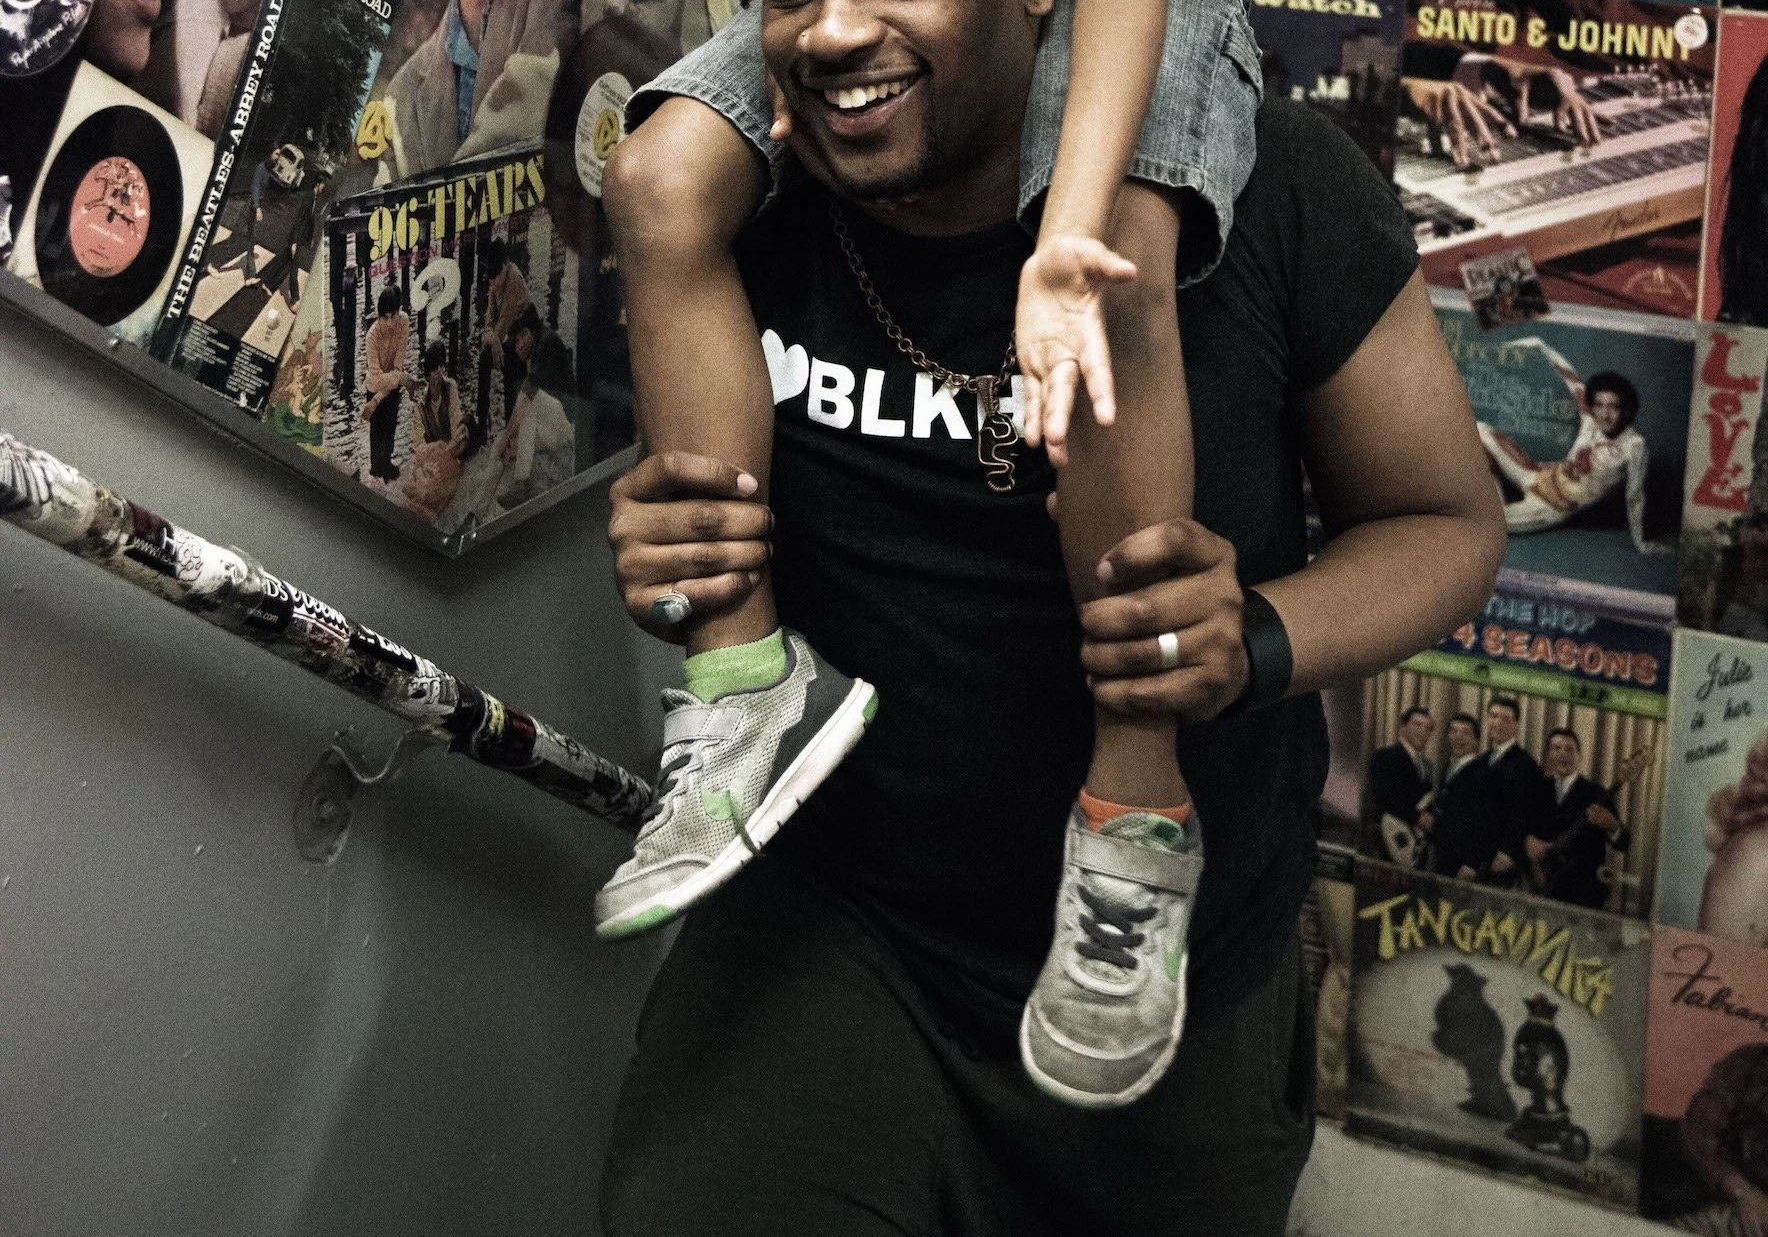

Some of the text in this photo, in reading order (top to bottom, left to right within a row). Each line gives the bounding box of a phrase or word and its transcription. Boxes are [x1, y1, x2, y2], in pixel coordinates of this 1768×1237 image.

[1416, 5, 1518, 48] SANTO
[1525, 16, 1549, 49] &
[367, 196, 421, 262] 96
[427, 153, 547, 243] TEARS
[166, 263, 197, 319] THE
[1453, 621, 1659, 686] 4 SEASONS
[1696, 651, 1753, 702] Julie
